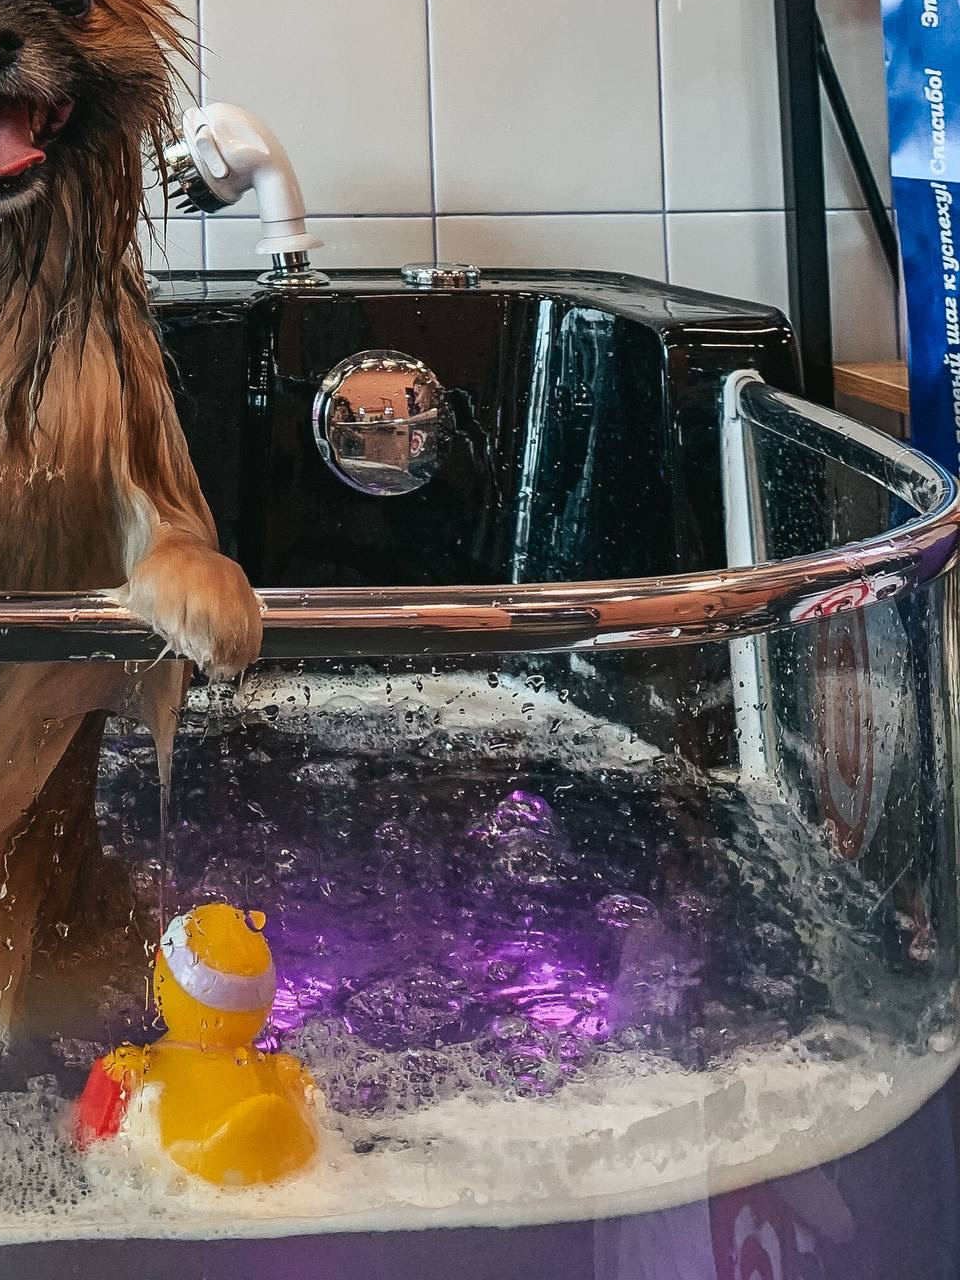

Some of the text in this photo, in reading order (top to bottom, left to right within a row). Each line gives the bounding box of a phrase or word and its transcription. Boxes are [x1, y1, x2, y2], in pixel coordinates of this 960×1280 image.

[924, 68, 946, 176] Спасибо!
[930, 181, 960, 272] успеху!
[943, 273, 957, 291] к
[945, 297, 960, 345] шаг
